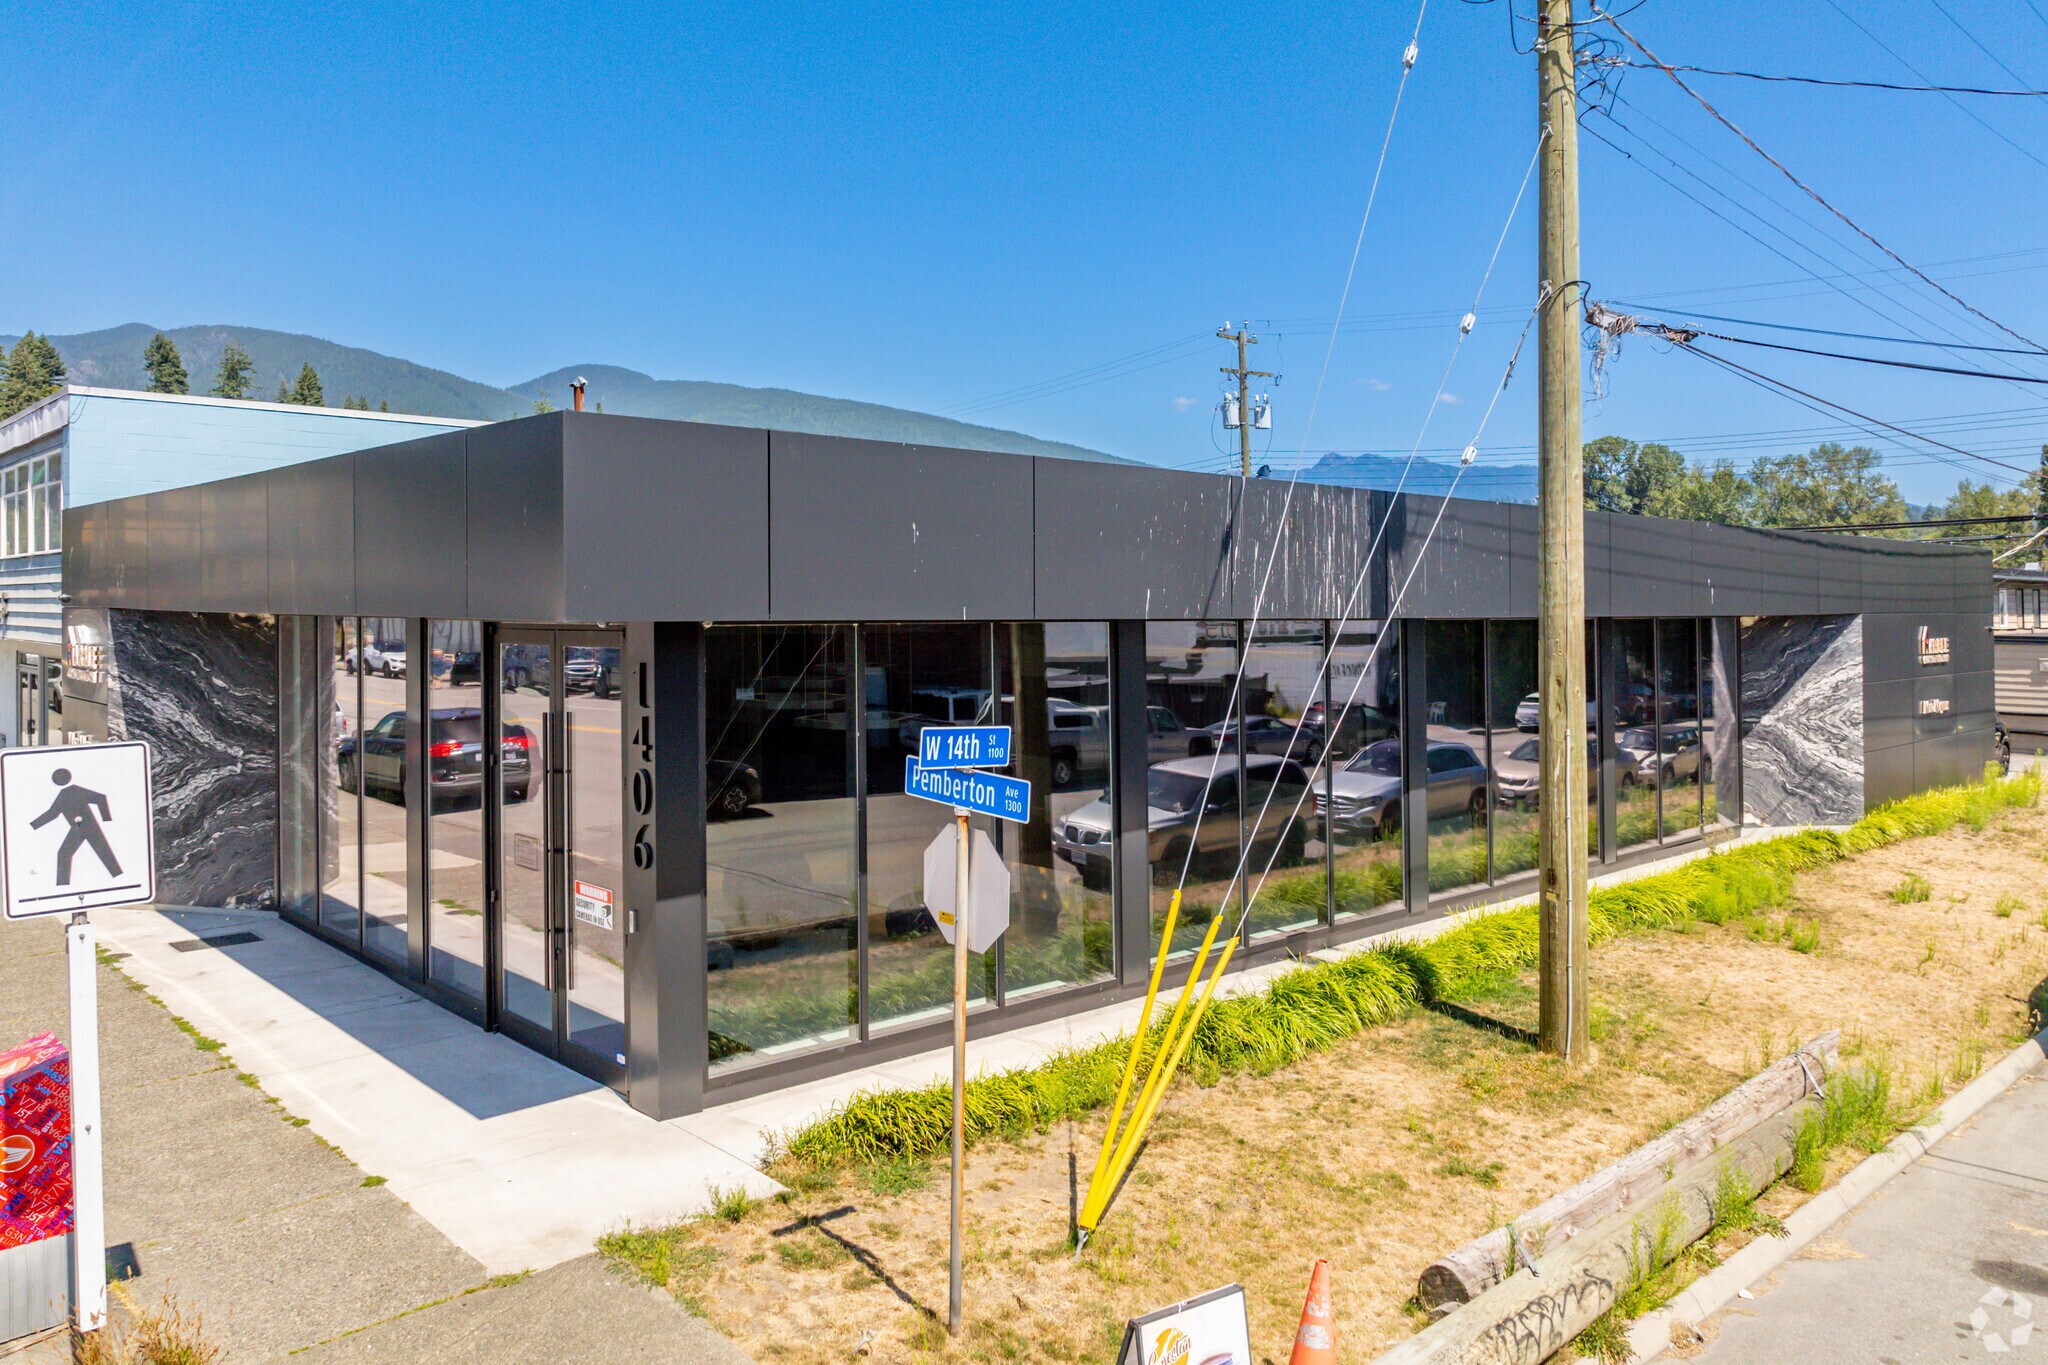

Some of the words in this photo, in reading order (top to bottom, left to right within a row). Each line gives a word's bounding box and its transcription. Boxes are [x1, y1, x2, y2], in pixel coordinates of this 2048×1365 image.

[926, 736, 941, 761] W
[947, 733, 980, 760] 14th
[988, 735, 997, 746] St
[988, 748, 1004, 759] 1100
[632, 662, 653, 870] 1406
[912, 764, 996, 807] Pemberton
[1005, 786, 1019, 799] Ave
[1005, 800, 1022, 813] 1300
[580, 884, 608, 902] WARNING
